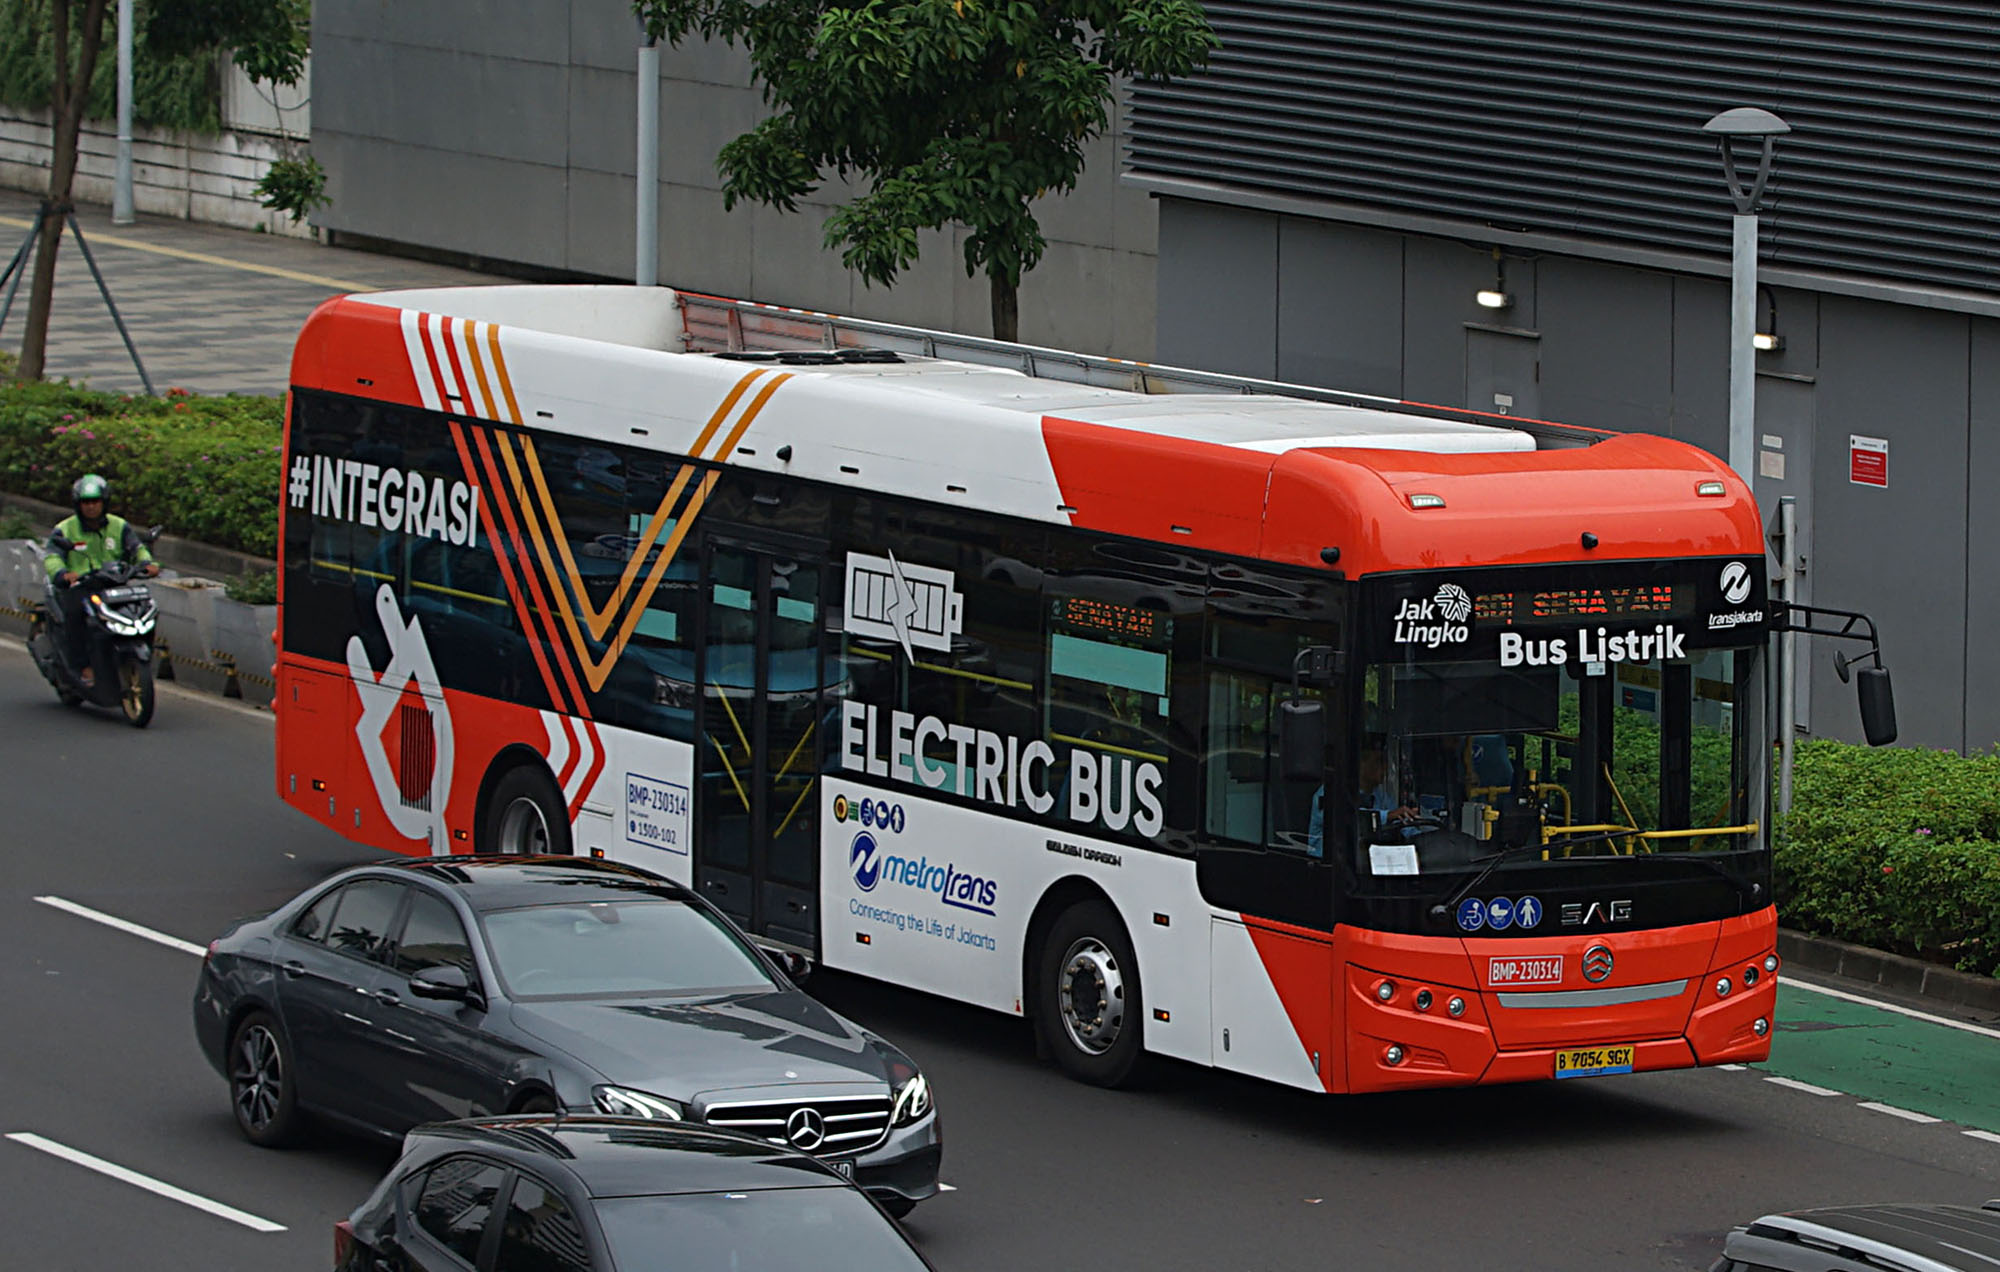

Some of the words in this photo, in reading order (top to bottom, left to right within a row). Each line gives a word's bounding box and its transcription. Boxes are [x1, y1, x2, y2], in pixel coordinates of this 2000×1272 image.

[289, 454, 479, 548] #INTEGRASI
[1394, 598, 1436, 621] Jak
[1533, 587, 1672, 617] SENAYAN
[1708, 609, 1763, 630] transjakarta
[1394, 621, 1469, 649] Lingko
[1500, 632, 1567, 667] Bus
[1579, 625, 1686, 663] Listrik
[841, 699, 1056, 815] ELECTRIC
[1070, 748, 1164, 838] BUS
[628, 783, 687, 817] BMP-230314
[638, 822, 676, 844] 1500-102
[882, 855, 998, 917] metrotrans
[849, 898, 905, 932] Connecting
[906, 914, 925, 932] the
[925, 918, 943, 938] Life
[944, 922, 956, 941] of
[956, 926, 997, 951] Jakarta
[1492, 960, 1560, 982] BMP-230314
[1559, 1053, 1567, 1070] B
[1606, 1048, 1631, 1065] SGX
